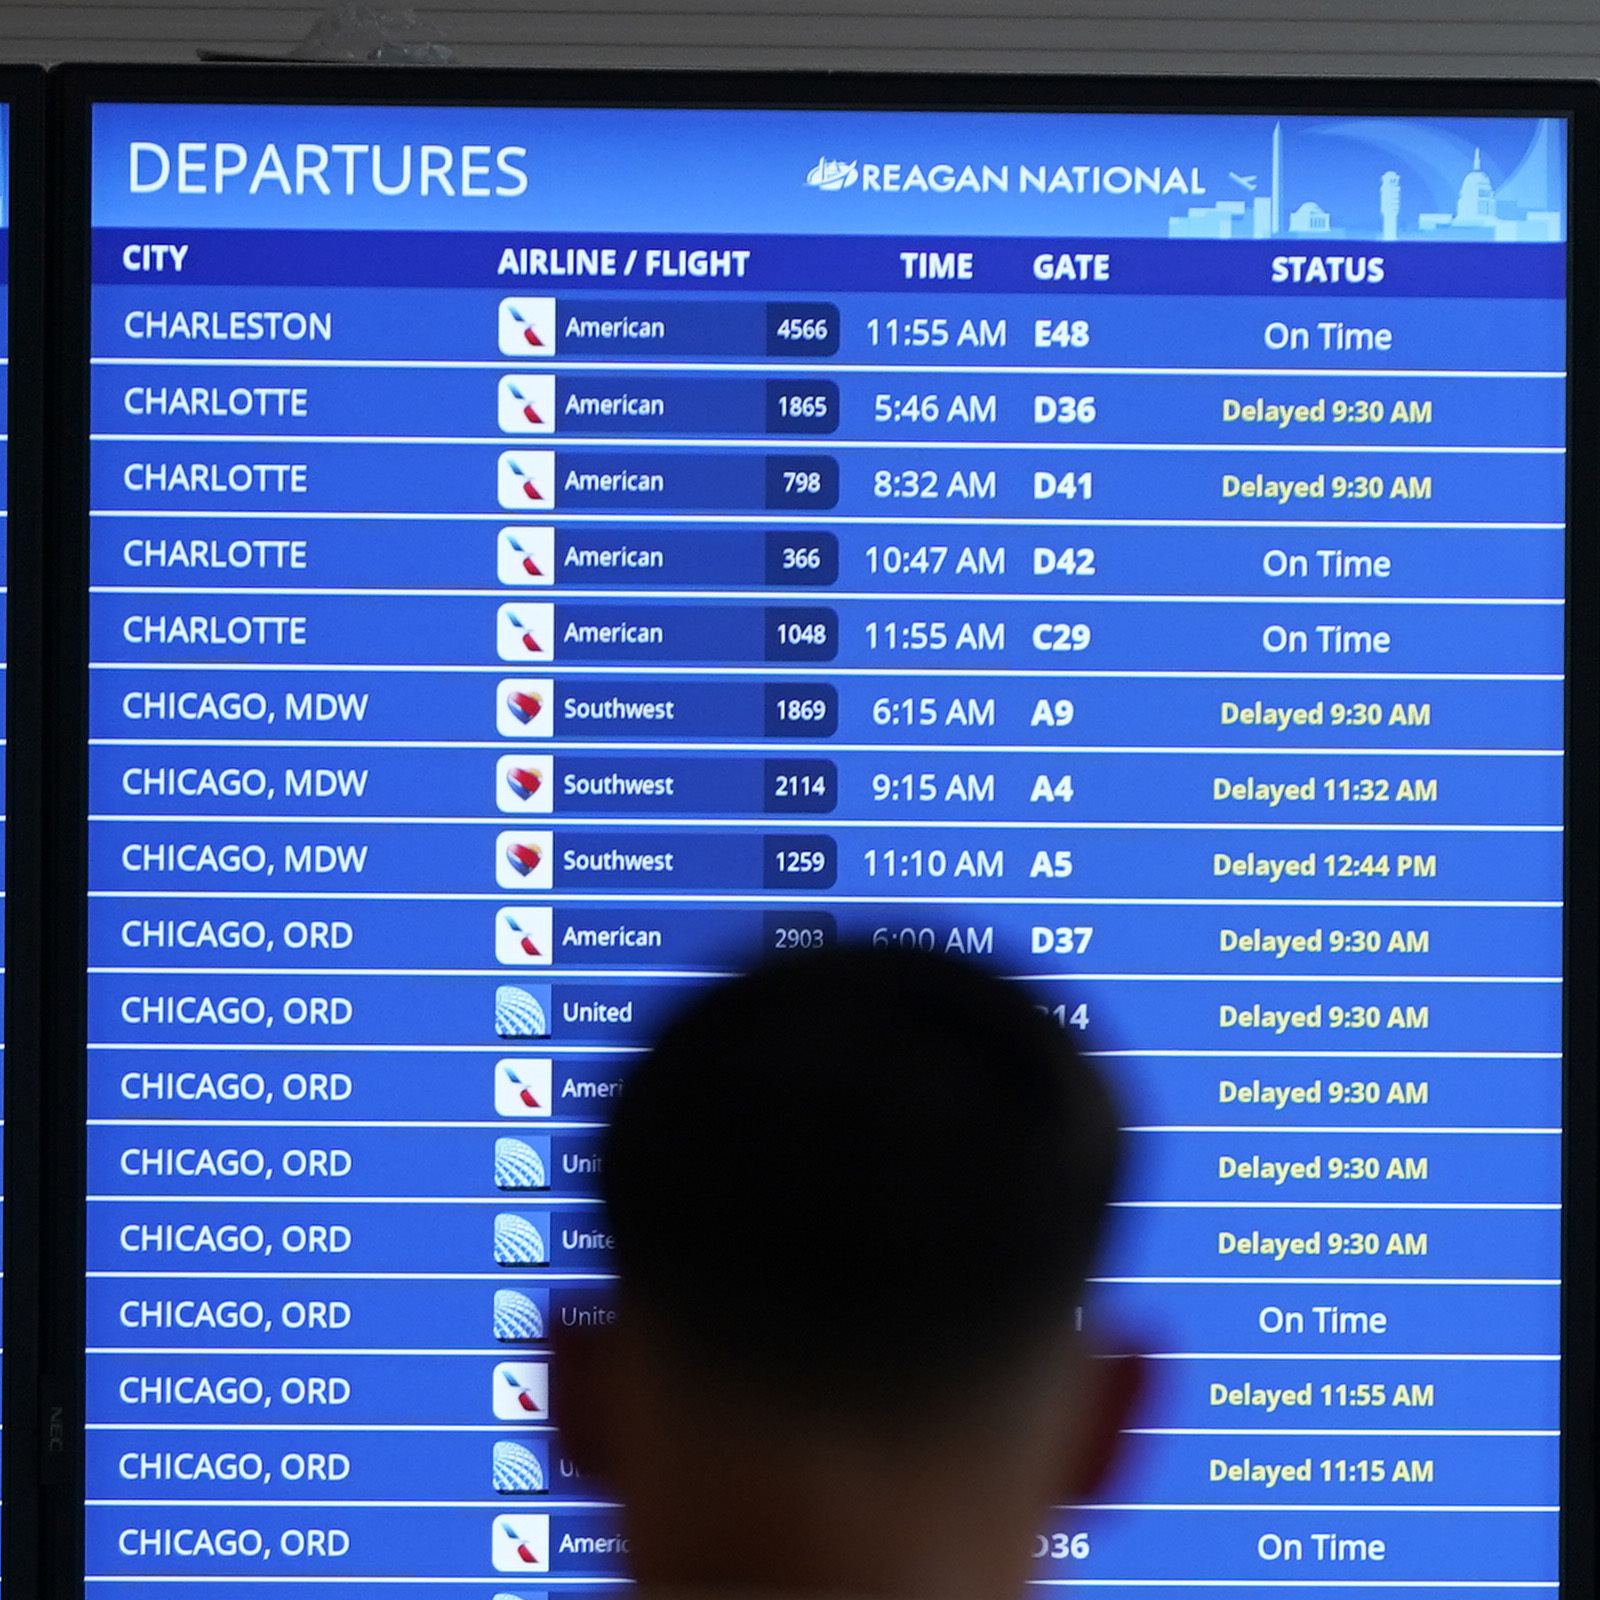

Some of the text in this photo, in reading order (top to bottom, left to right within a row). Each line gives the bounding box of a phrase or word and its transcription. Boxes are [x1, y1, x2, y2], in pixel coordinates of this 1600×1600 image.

[129, 142, 528, 198] DEPARTURES
[862, 163, 1206, 196] REAGAN NATIONAL
[122, 244, 1385, 284] CITY AIRLINE / FLIGHT TIME GATE STATUS
[124, 310, 1393, 351] CHARLESTON American 4566 11:55 AM E48 On Time
[122, 767, 1438, 808] CHICAGO, MDW Southwest 2114 9:15 AM A4 Delayed 11:32 AM
[49, 1406, 63, 1452] NEC
